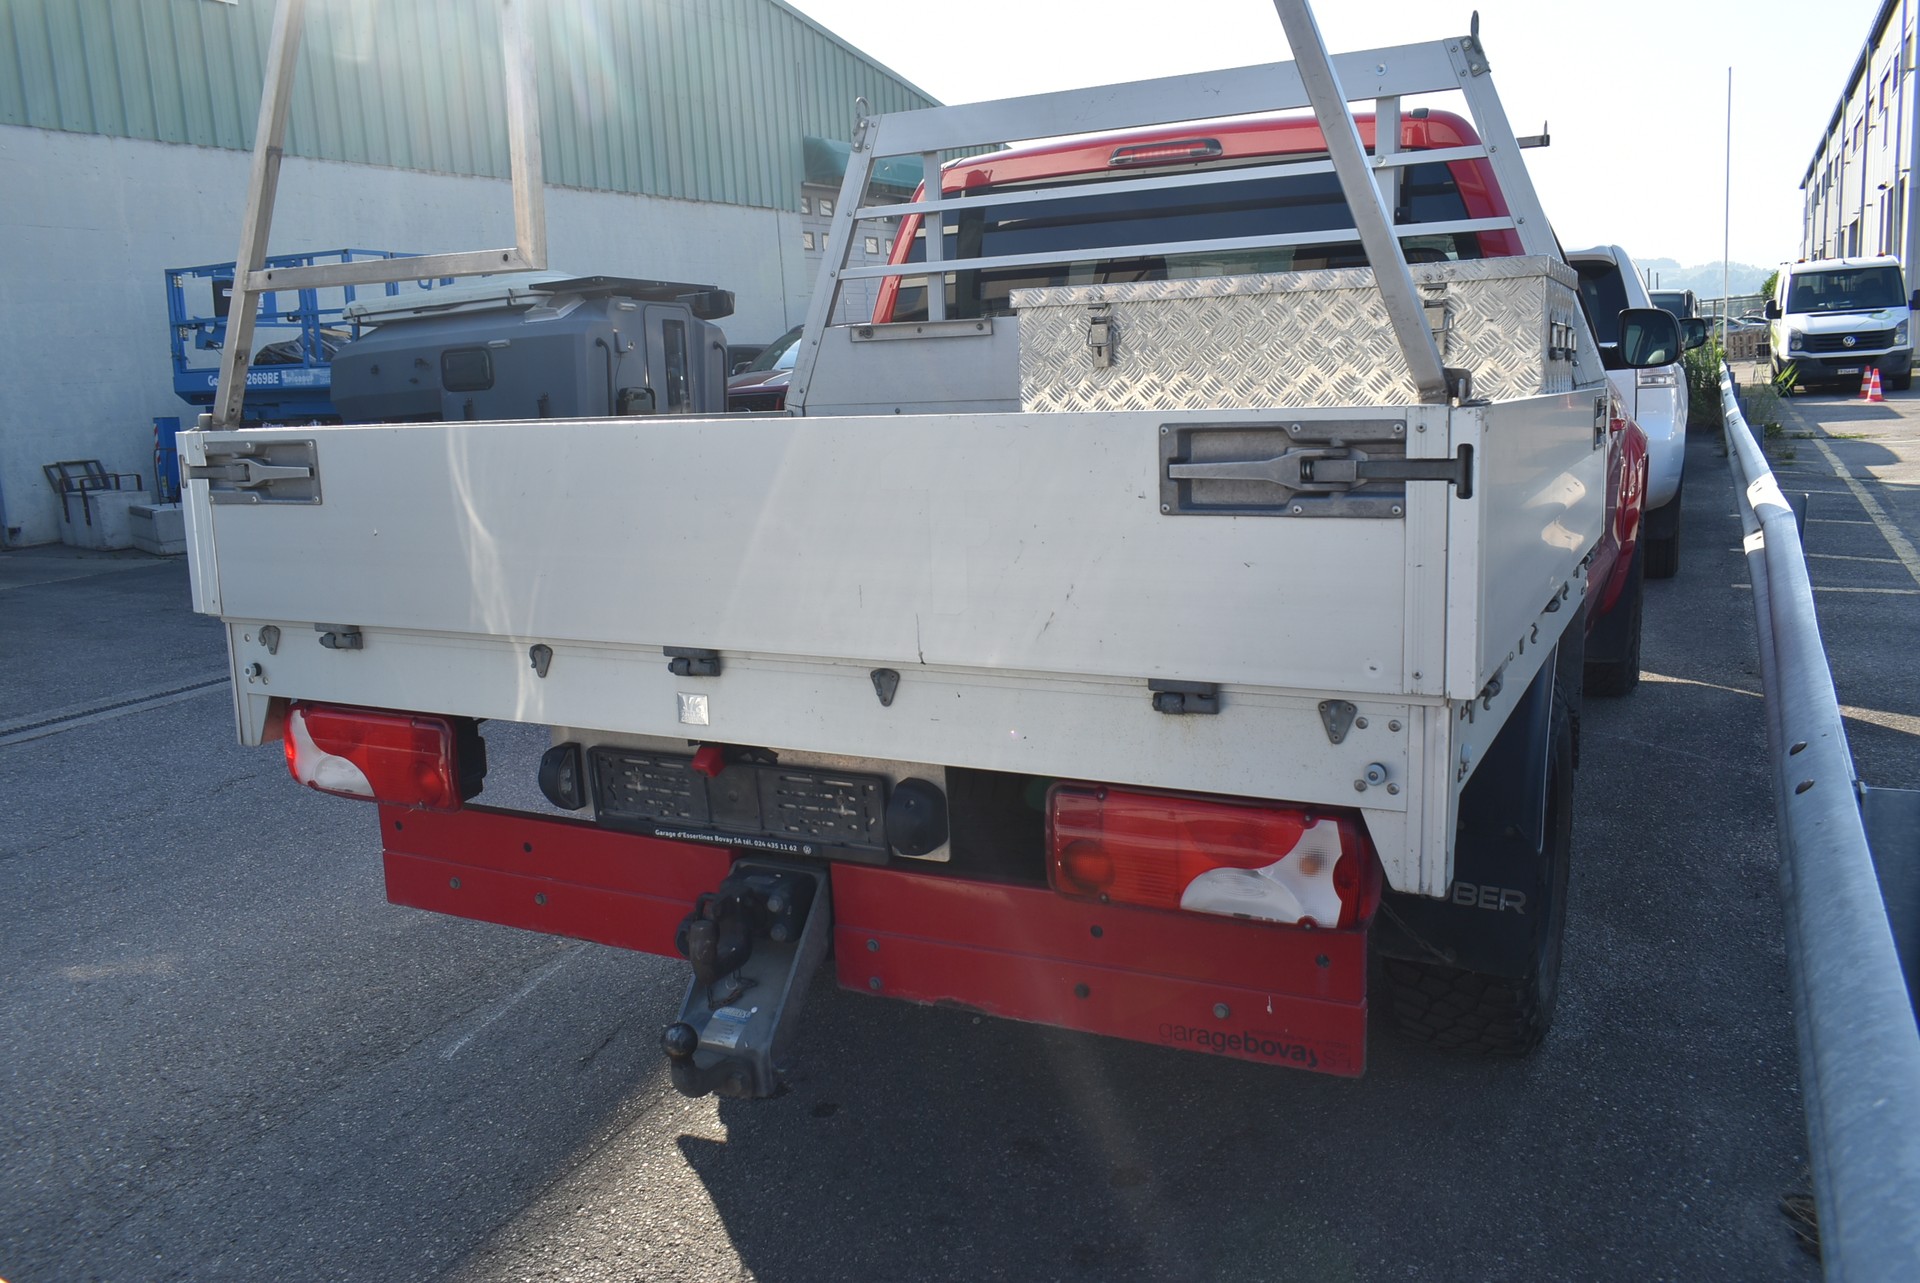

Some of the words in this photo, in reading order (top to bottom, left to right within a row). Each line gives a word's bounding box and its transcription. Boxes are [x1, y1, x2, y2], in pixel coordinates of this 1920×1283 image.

[246, 372, 279, 385] 2669BE
[655, 829, 676, 838] Garage
[677, 831, 713, 841] d'Essertines
[714, 835, 733, 845] Bovay
[754, 840, 766, 848] 024
[780, 843, 788, 851] 11
[789, 844, 797, 852] 62
